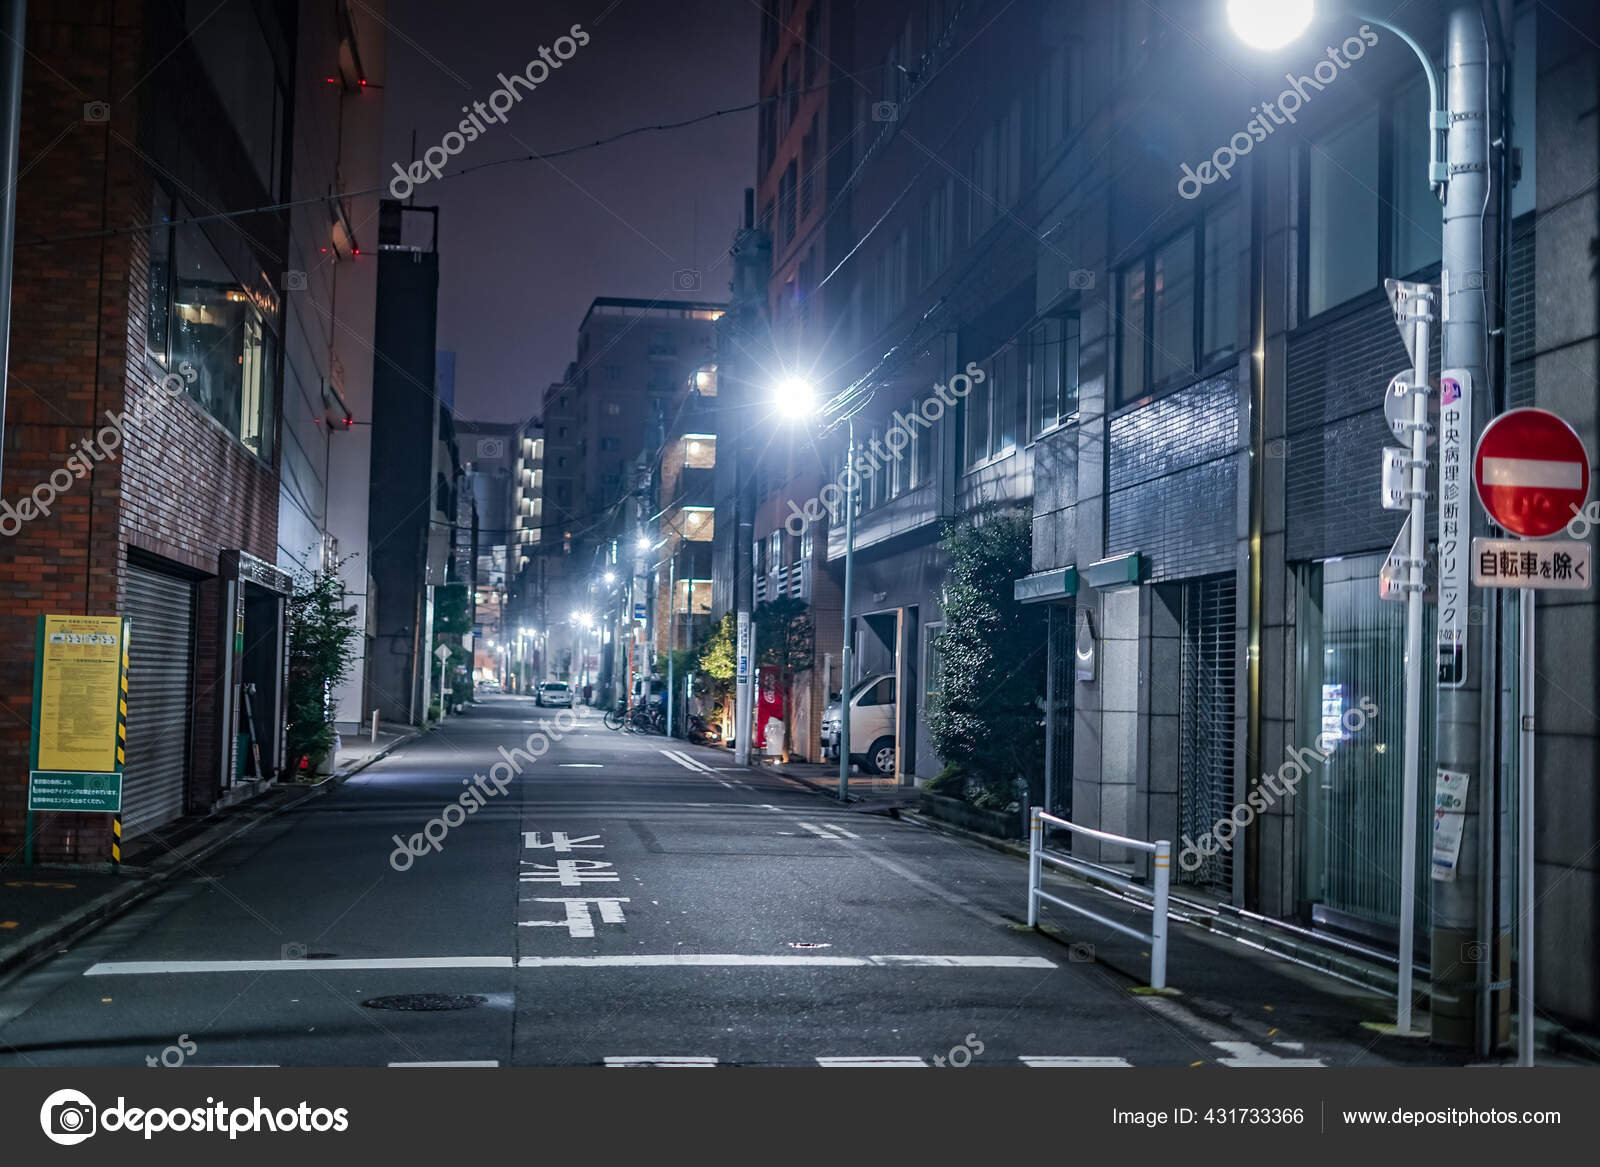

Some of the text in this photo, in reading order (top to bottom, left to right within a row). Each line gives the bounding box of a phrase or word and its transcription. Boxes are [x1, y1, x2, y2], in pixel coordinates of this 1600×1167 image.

[1442, 409, 1461, 624] 中央病理診断科クリニック
[1480, 549, 1586, 581] 自転車を除く
[517, 831, 631, 938] 止まれ
